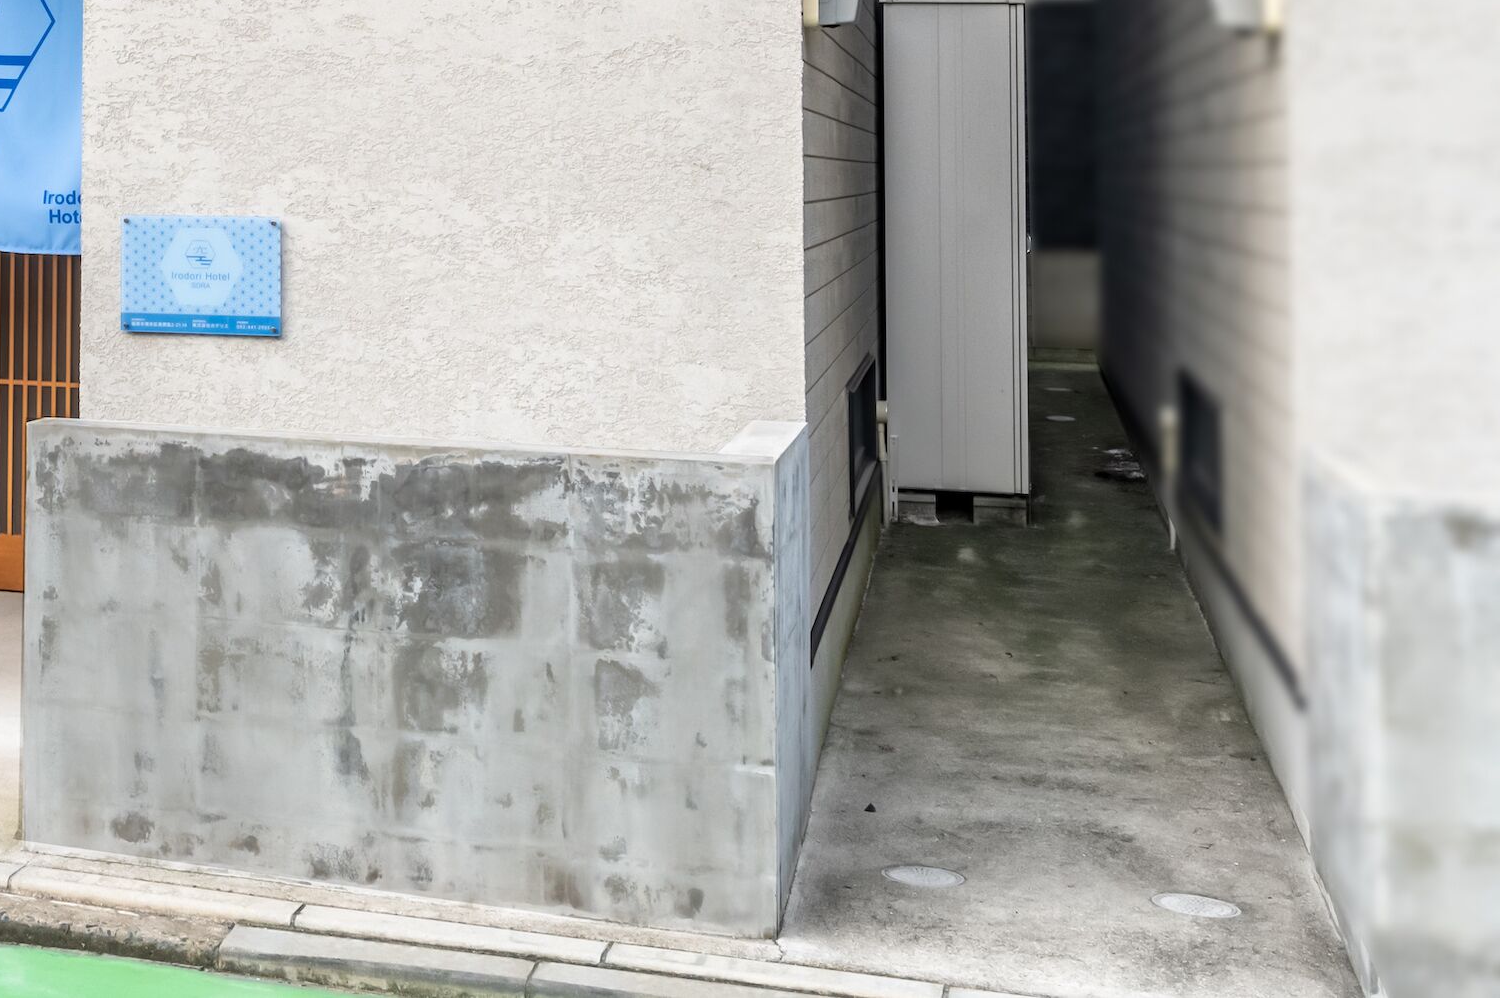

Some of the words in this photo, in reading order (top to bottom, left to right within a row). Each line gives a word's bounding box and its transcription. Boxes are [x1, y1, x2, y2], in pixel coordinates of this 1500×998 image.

[49, 209, 81, 224] Hot
[171, 271, 202, 281] Irodori
[205, 272, 230, 282] Hotel
